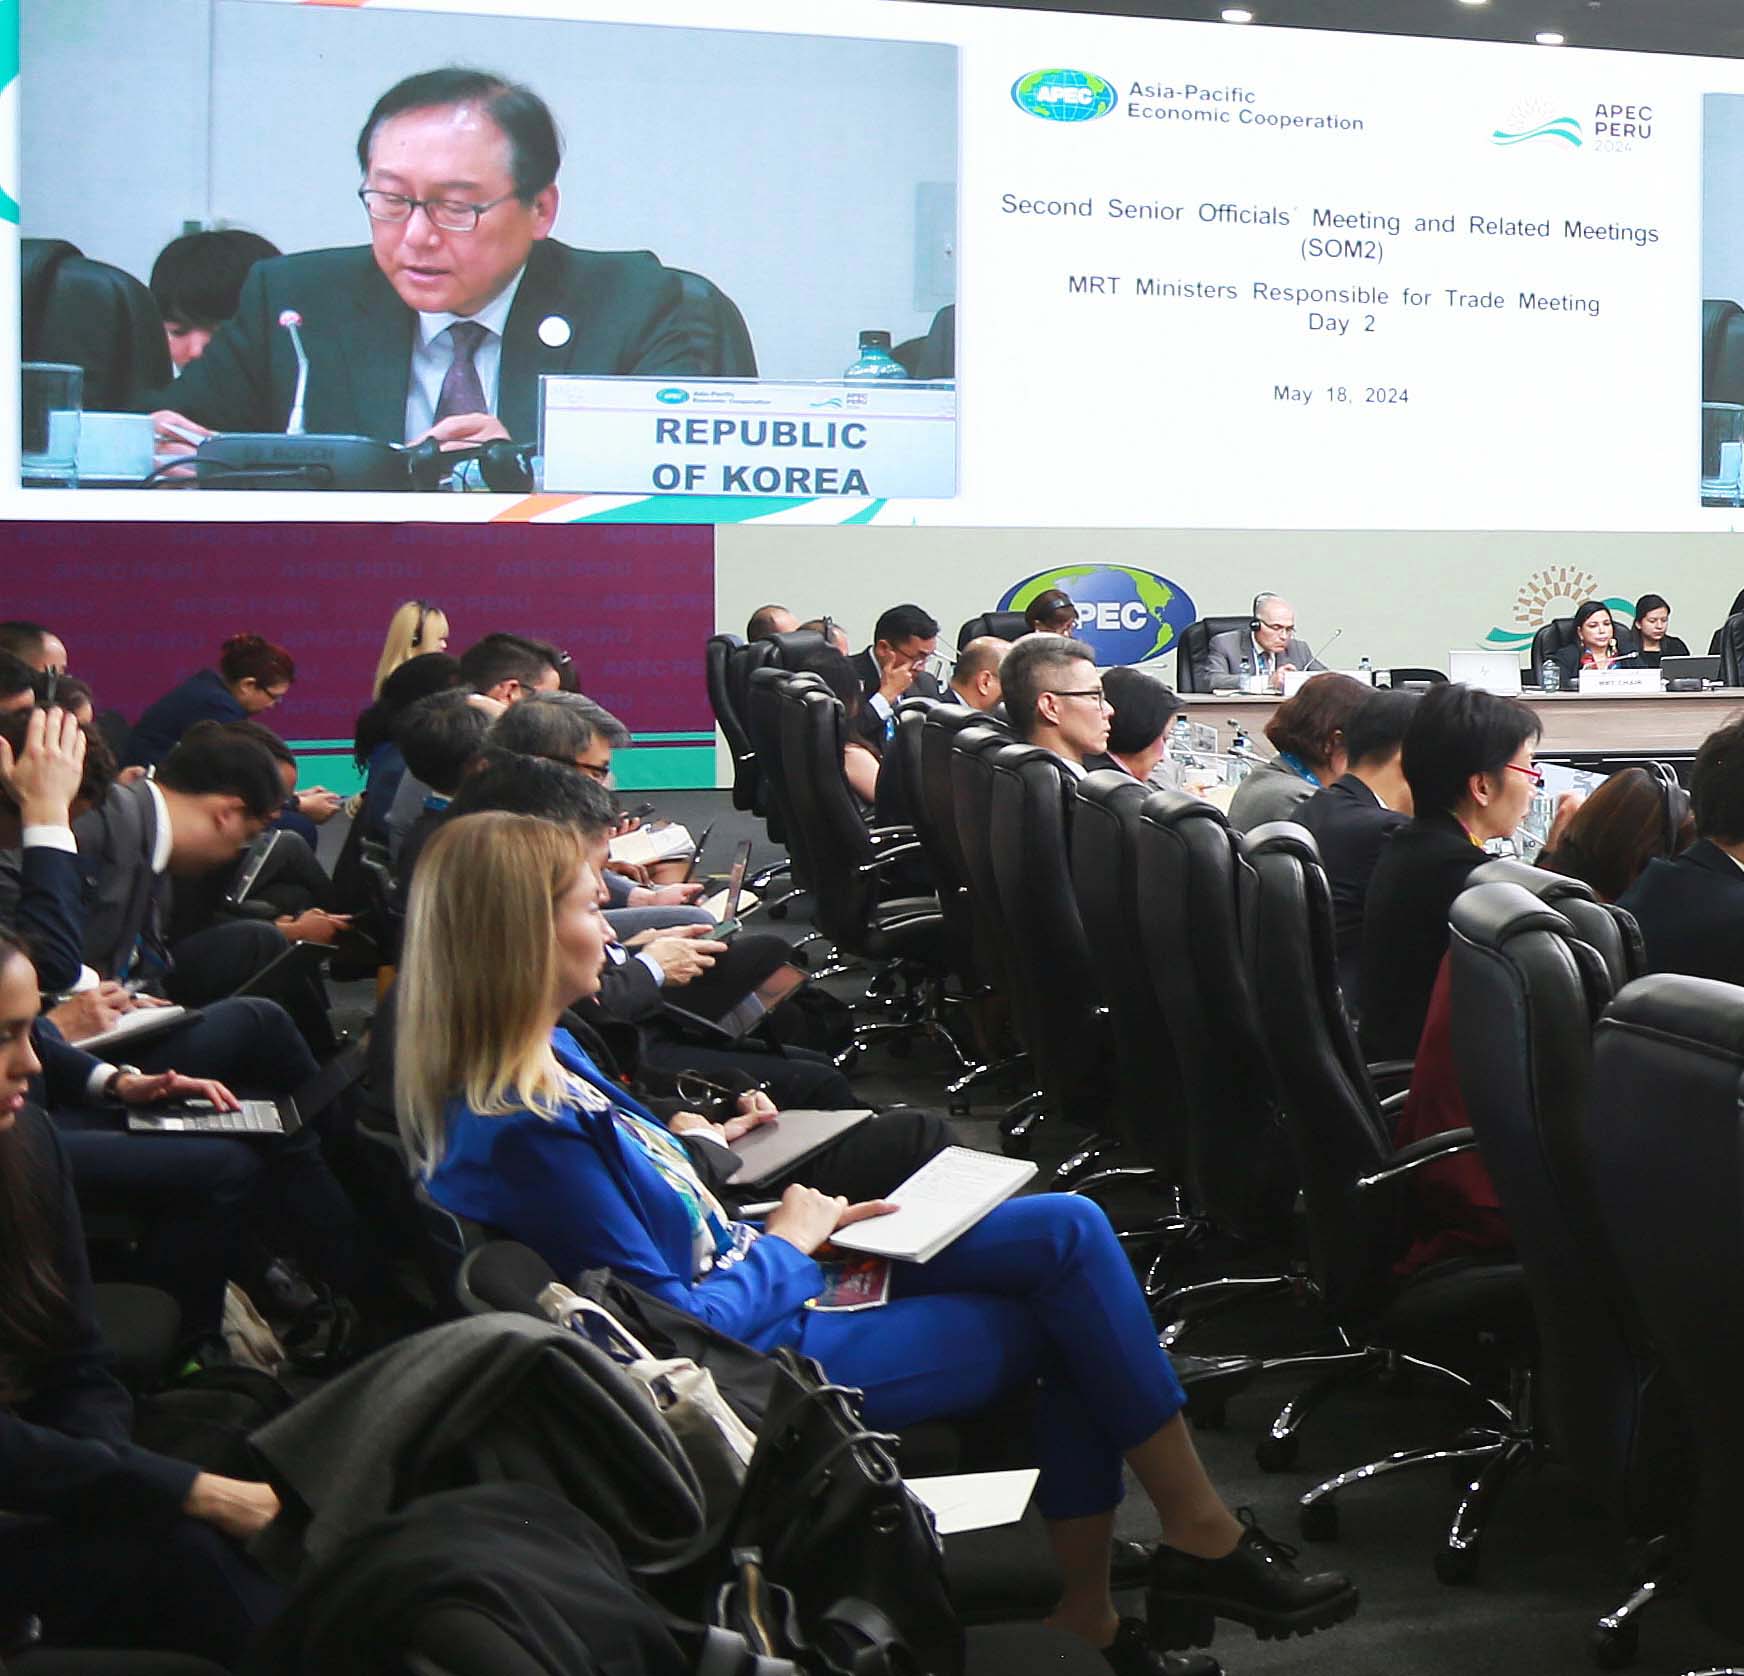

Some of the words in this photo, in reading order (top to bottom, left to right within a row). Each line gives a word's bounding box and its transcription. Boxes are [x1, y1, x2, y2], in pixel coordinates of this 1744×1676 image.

[1129, 81, 1256, 104] Asia-Pacific
[1128, 102, 1230, 123] Economic
[1239, 108, 1364, 132] Cooperation
[1595, 103, 1653, 121] APEC
[1595, 122, 1652, 139] PERU
[1001, 193, 1093, 217] Second
[1108, 198, 1185, 221] Senior
[1312, 208, 1400, 236] Meeting
[1414, 212, 1455, 233] and
[1469, 215, 1550, 238] Related
[1564, 219, 1659, 246] Meetings
[1301, 237, 1383, 265] (SOM2)
[1068, 275, 1121, 295] MRT
[1136, 277, 1238, 300] Ministers
[1253, 282, 1389, 308] Responsible
[1402, 287, 1433, 307] for
[1444, 289, 1505, 310] Trade
[1519, 292, 1600, 317] Meeting
[1308, 312, 1350, 336] Day
[1363, 314, 1376, 332] 2
[1274, 385, 1313, 406] May
[1365, 387, 1409, 404] 2024
[656, 418, 867, 450] REPUBLIC
[652, 463, 707, 491] OF
[722, 465, 870, 495] KOREA
[1075, 601, 1148, 631] PEC
